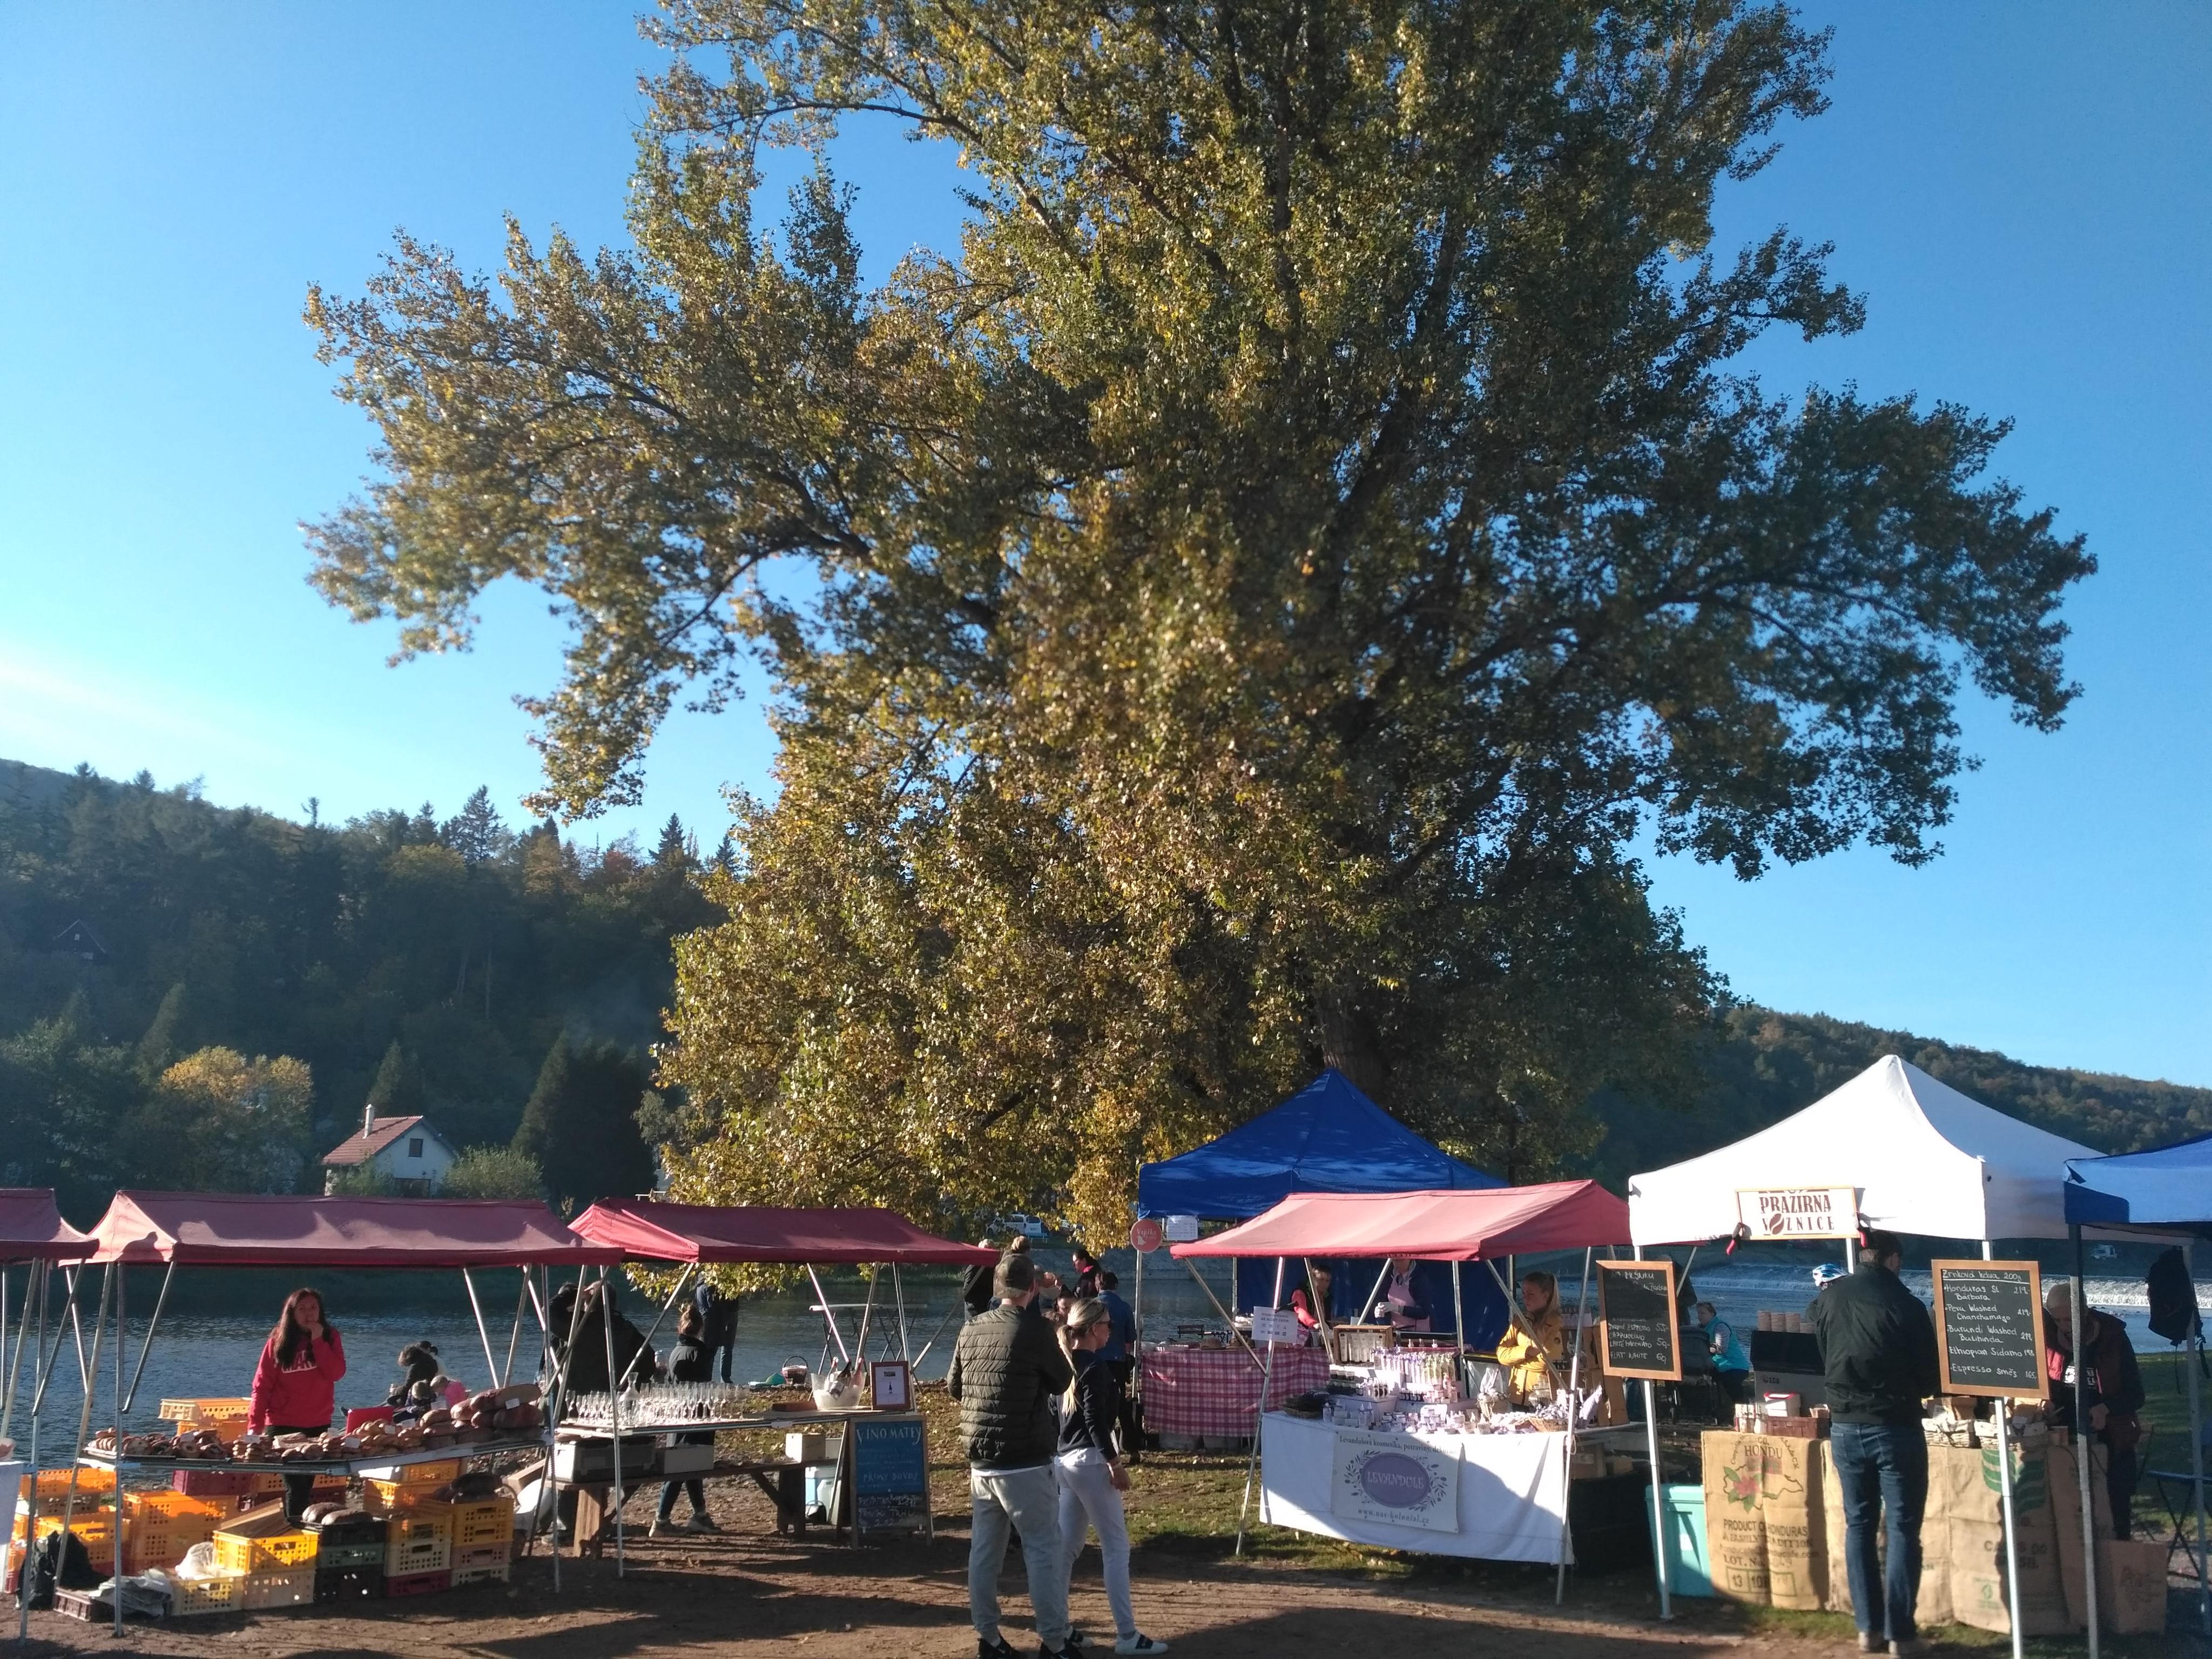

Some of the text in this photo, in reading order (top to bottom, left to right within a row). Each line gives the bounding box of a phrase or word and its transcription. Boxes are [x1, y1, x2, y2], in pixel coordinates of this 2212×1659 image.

[1943, 1270, 2022, 1282] Zrnková káva 200g
[1946, 1283, 1986, 1292] Honduras
[1946, 1304, 1966, 1312] Peru
[1968, 1304, 1997, 1312] Washed
[1957, 1313, 2011, 1323] Chanchamayo
[1608, 1332, 1645, 1340] CAPPUCCINO
[1947, 1324, 1983, 1333] Burundi
[1987, 1325, 2017, 1336] Washed
[1610, 1351, 1626, 1359] FLAT
[1949, 1346, 1988, 1358] Ethiopian
[1991, 1347, 2022, 1357] Sidamo
[1952, 1363, 1992, 1375] Espresso
[1996, 1368, 2017, 1378] směs
[1340, 1435, 1372, 1446] Levandulová
[1373, 1439, 1401, 1449] kosmetika,
[1744, 1445, 1783, 1459] HONDU
[1367, 1471, 1424, 1489] LEVANDULE
[1723, 1518, 1756, 1532] PRODUCT
[1758, 1521, 1766, 1532] O
